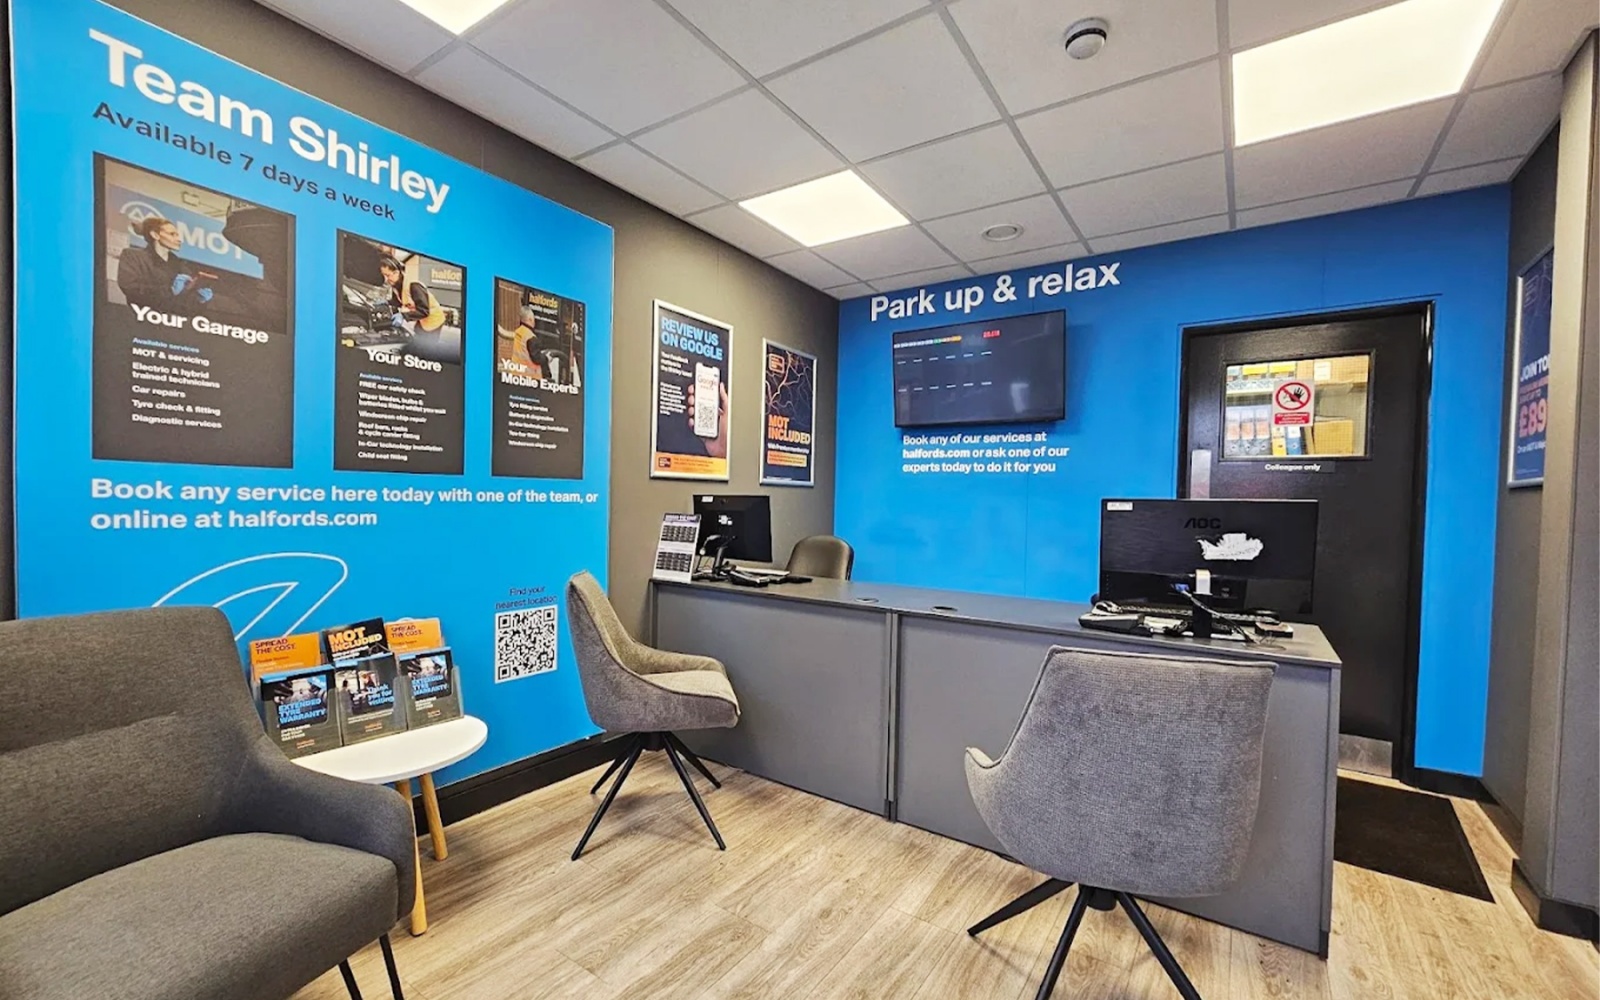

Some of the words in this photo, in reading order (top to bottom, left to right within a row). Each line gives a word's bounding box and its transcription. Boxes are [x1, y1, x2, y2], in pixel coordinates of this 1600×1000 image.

[89, 28, 273, 145] Team
[289, 116, 450, 214] Shirley
[93, 102, 232, 165] Available
[240, 154, 256, 171] 7
[262, 164, 319, 196] days
[325, 188, 336, 201] a
[342, 191, 396, 221] week
[871, 288, 936, 322] Park
[944, 285, 984, 314] up
[993, 275, 1017, 303] &
[1028, 262, 1120, 299] relax
[130, 303, 187, 328] Your
[192, 316, 269, 344] Garage
[661, 316, 704, 342] REVIEW
[704, 331, 719, 346] US
[661, 332, 679, 348] ON
[680, 338, 723, 361] GOOGLE
[132, 347, 158, 358] MOT
[158, 351, 166, 360] &
[168, 352, 210, 367] servicing
[366, 348, 402, 366] Your
[404, 354, 442, 372] Store
[502, 358, 527, 372] Your
[132, 362, 170, 374] Electric
[171, 366, 179, 376] &
[181, 368, 210, 380] hybrid
[1520, 362, 1537, 382] JOIN
[1537, 355, 1548, 374] TO
[132, 372, 167, 383] trained
[168, 375, 220, 389] technicians
[501, 372, 538, 388] Mobile
[540, 379, 579, 394] Experts
[132, 385, 150, 394] Car
[152, 388, 186, 399] repairs
[132, 399, 154, 410] Tyre
[155, 402, 184, 412] check
[186, 404, 193, 413] &
[195, 406, 221, 417] fitting
[132, 414, 184, 426] Diagnostic
[185, 418, 222, 429] services
[768, 414, 789, 429] MOT
[1519, 398, 1546, 438] £89
[768, 427, 811, 445] INCLUDED
[903, 435, 928, 446] Book
[930, 436, 948, 448] any
[950, 434, 961, 444] of
[962, 435, 982, 444] our
[983, 432, 1032, 443] services
[1034, 432, 1047, 442] at
[902, 448, 970, 459] halfords.com
[972, 449, 984, 458] or
[985, 447, 1006, 457] ask
[1008, 448, 1030, 458] one
[1033, 446, 1046, 457] of
[1048, 447, 1070, 457] our
[902, 463, 940, 474] experts
[942, 462, 972, 474] today
[973, 463, 985, 472] to
[986, 462, 1002, 472] do
[1003, 462, 1012, 472] it
[1013, 462, 1032, 472] for
[1033, 463, 1055, 475] you
[1265, 463, 1303, 472] Colleague
[1304, 463, 1321, 472] only
[91, 478, 173, 502] Book
[180, 482, 231, 505] any
[236, 484, 326, 503] service
[331, 485, 378, 503] here
[382, 487, 434, 507] today
[438, 488, 473, 503] with
[476, 491, 504, 503] one
[508, 489, 522, 503] of
[524, 490, 546, 504] the
[549, 492, 582, 506] team,
[585, 493, 598, 503] or
[91, 510, 186, 530] online
[194, 511, 222, 528] at
[228, 510, 378, 528] halfords.com
[1184, 518, 1221, 529] AOC
[510, 587, 527, 596] Find
[528, 586, 545, 596] your
[496, 598, 526, 610] nearest
[328, 626, 366, 644] MOT
[255, 638, 288, 649] SPREAD
[256, 647, 273, 655] THE
[274, 644, 296, 652] COST
[331, 634, 383, 653] INCLUDED
[412, 674, 444, 686] EXTENDED
[381, 689, 392, 698] for
[413, 684, 449, 696] WARRANTY
[278, 698, 322, 711] EXTENDED
[279, 708, 300, 718] TYRE
[280, 709, 327, 724] WARRANTY
